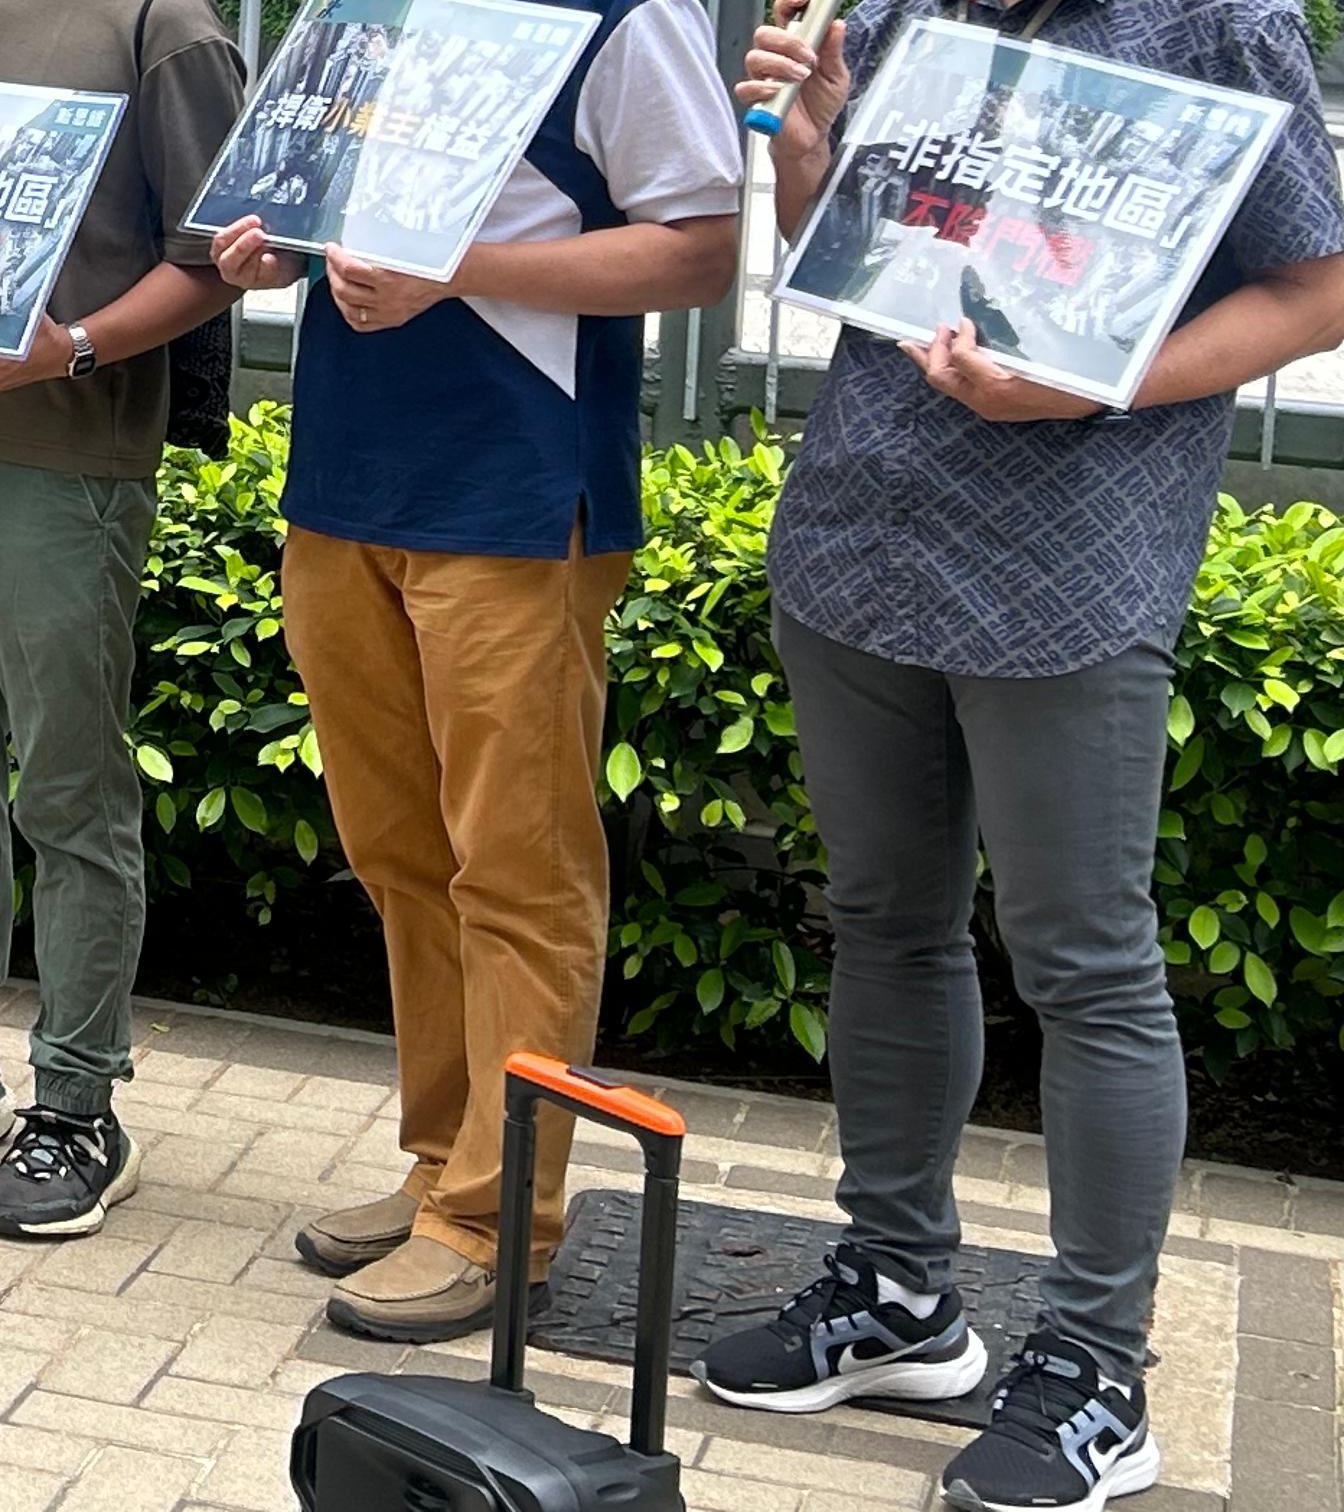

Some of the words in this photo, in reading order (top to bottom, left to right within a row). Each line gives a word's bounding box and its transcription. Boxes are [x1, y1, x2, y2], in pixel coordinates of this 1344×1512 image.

[876, 110, 1193, 250] 「非指定地區」
